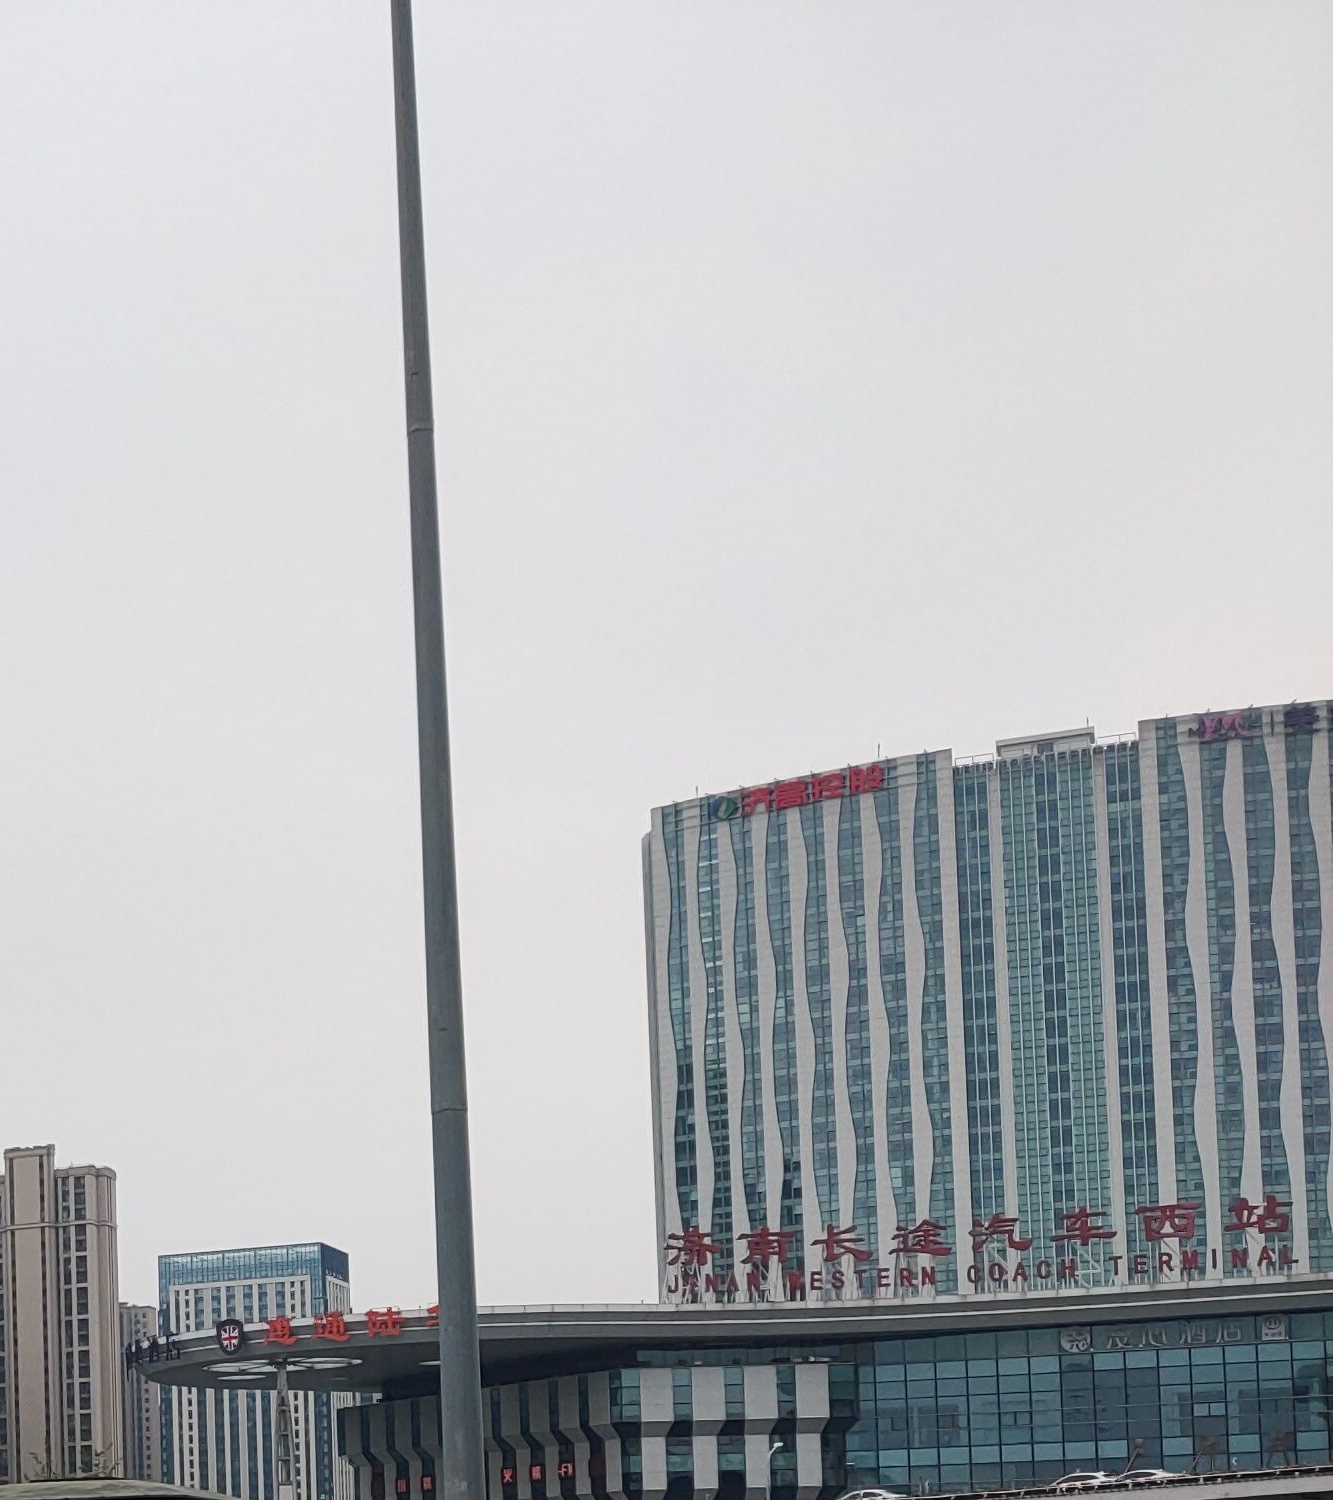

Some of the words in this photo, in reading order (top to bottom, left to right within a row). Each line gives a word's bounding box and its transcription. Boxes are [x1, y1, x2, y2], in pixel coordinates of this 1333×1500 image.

[664, 1195, 1293, 1266] 济南长途汽车西站
[786, 1266, 936, 1292] WESTERN
[966, 1257, 1078, 1285] COACH
[1107, 1246, 1300, 1276] TERMINAL
